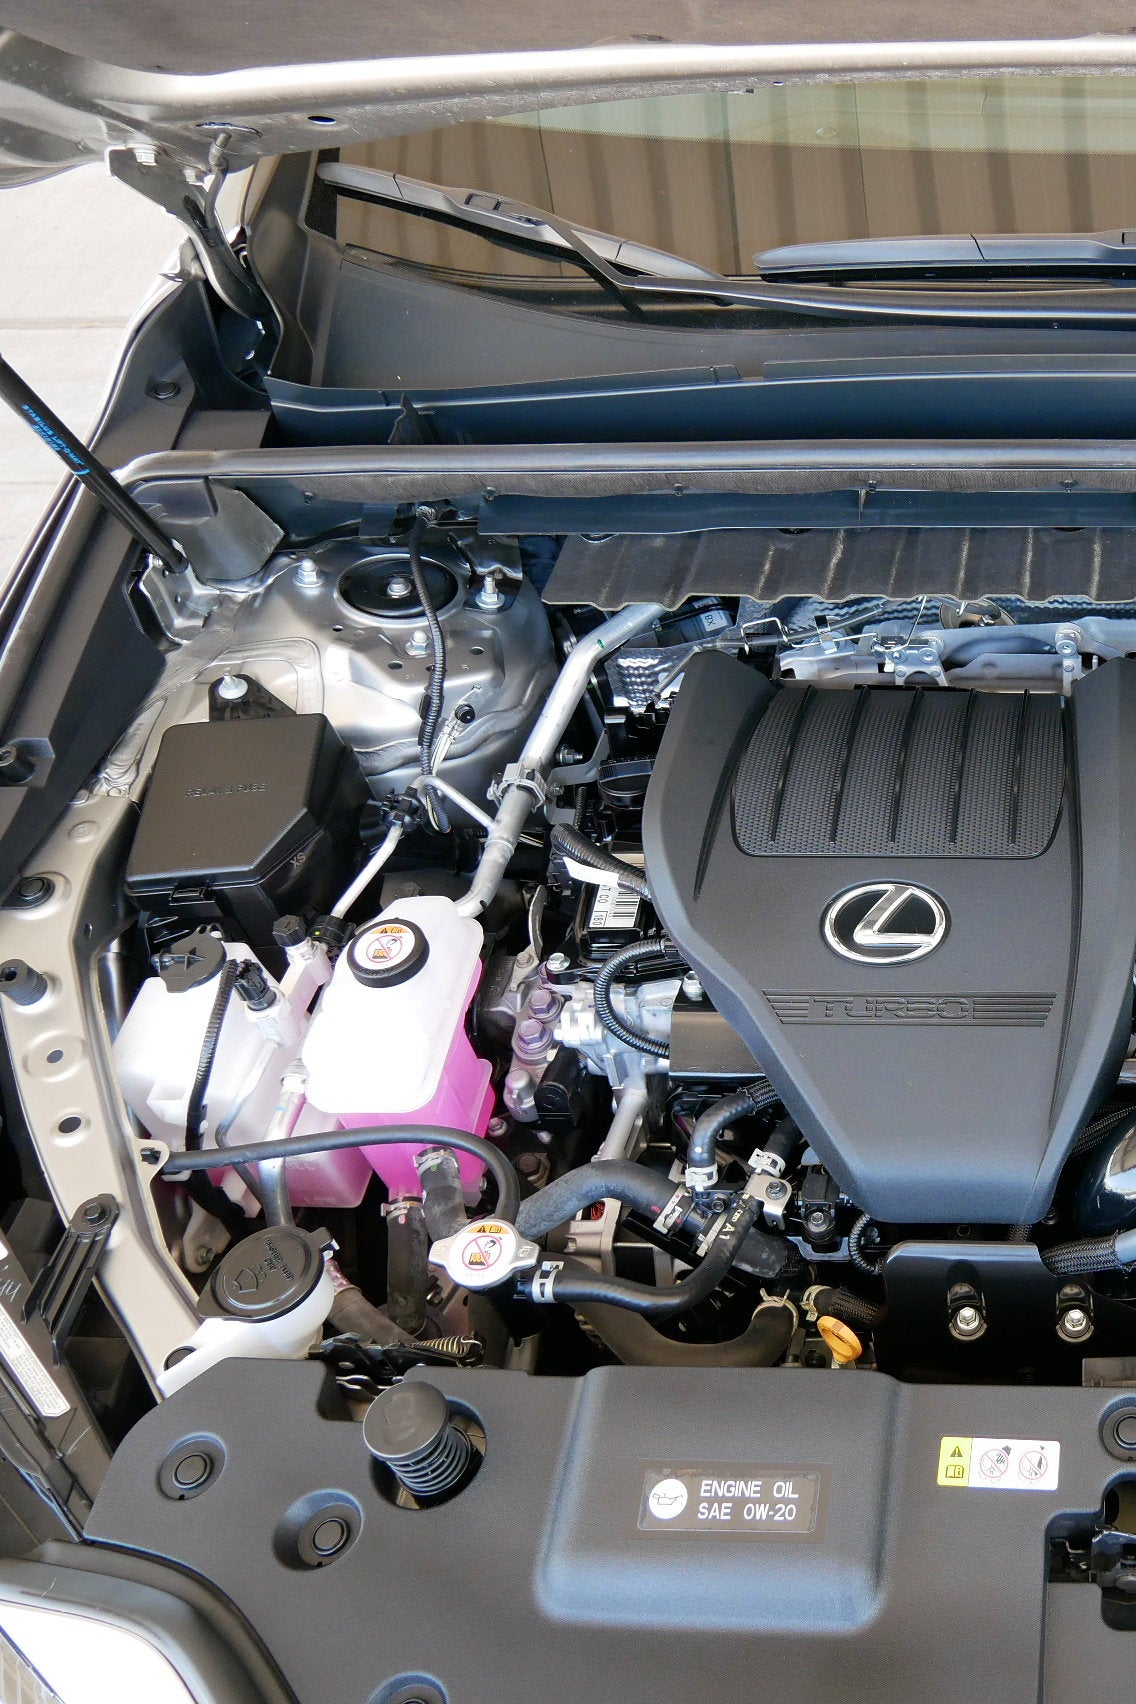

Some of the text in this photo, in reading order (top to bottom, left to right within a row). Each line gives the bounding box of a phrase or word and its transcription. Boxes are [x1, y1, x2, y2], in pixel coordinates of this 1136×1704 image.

[813, 996, 969, 1018] TURBO
[700, 1480, 799, 1499] ENGINE OIL
[697, 1502, 797, 1521] SAE 0W-20
